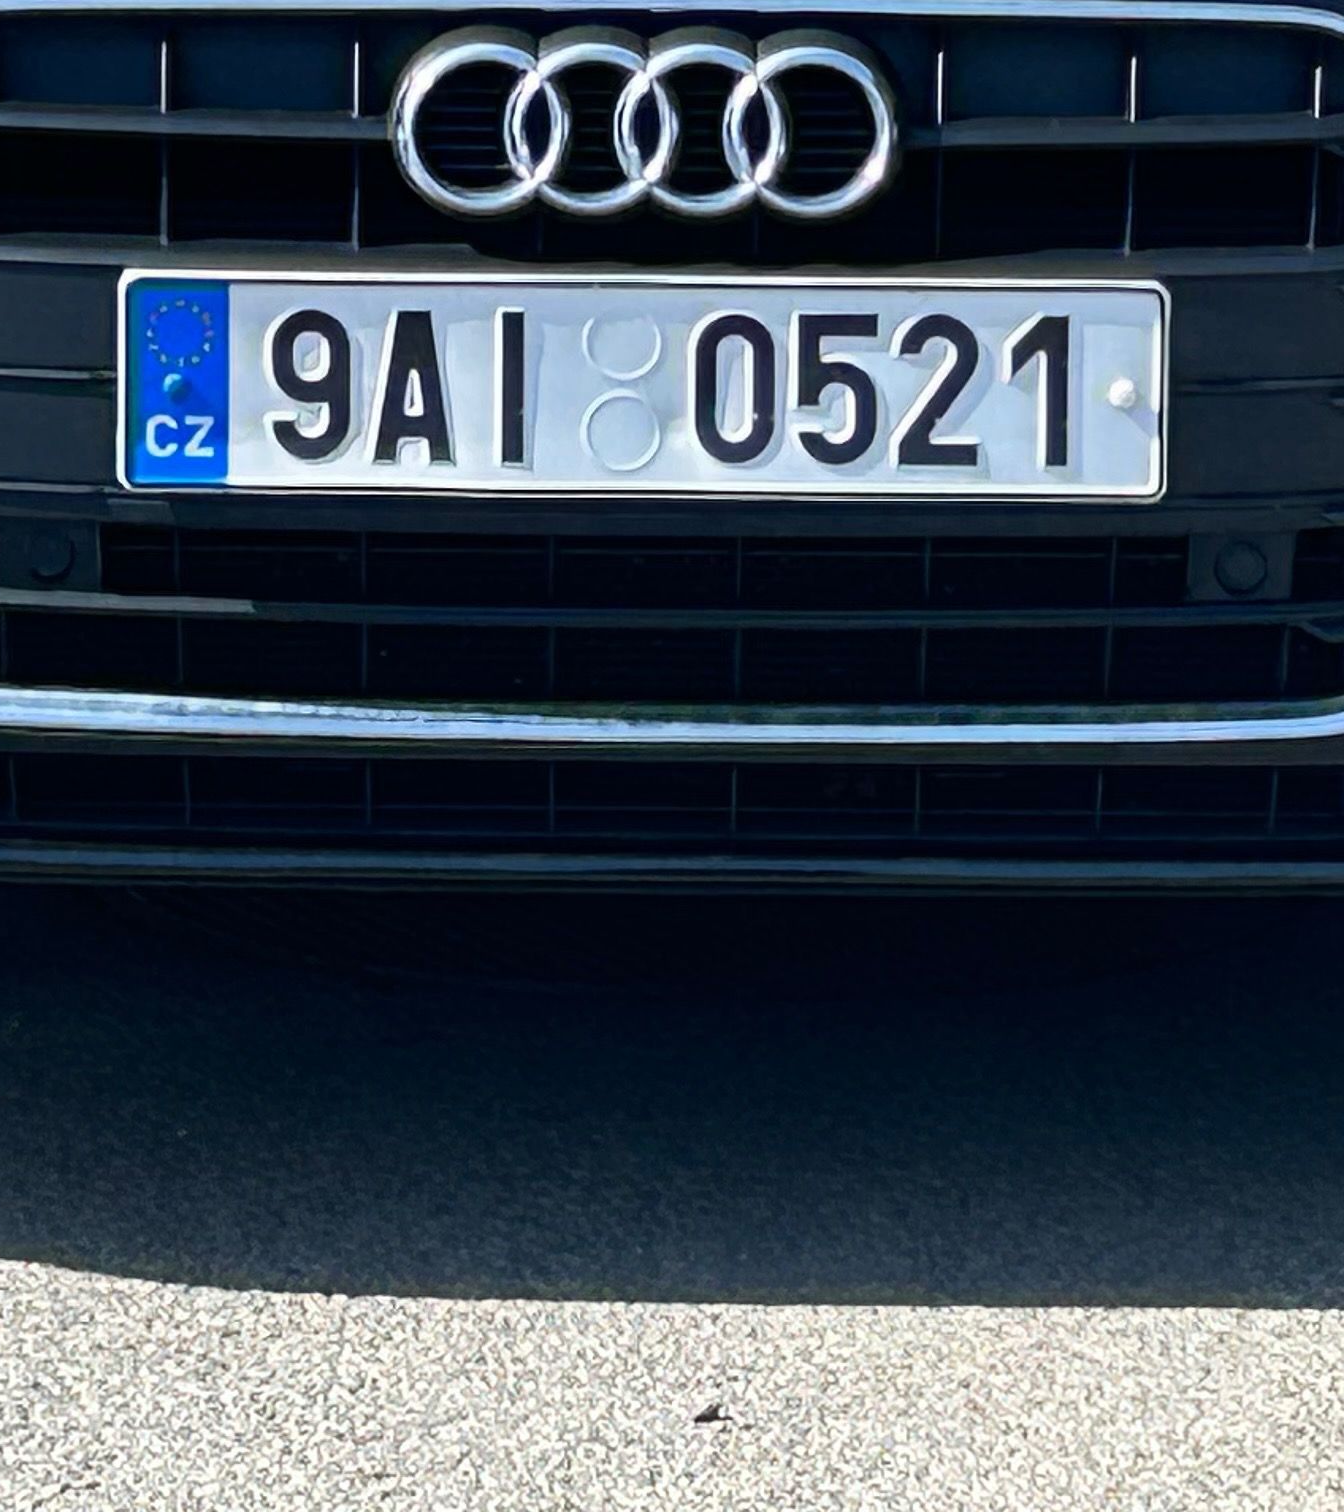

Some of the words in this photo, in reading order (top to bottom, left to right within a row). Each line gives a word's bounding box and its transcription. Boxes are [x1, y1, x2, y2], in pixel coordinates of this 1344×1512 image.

[145, 414, 215, 458] CZ
[271, 309, 526, 464] 9AI
[694, 312, 1070, 467] 0521
